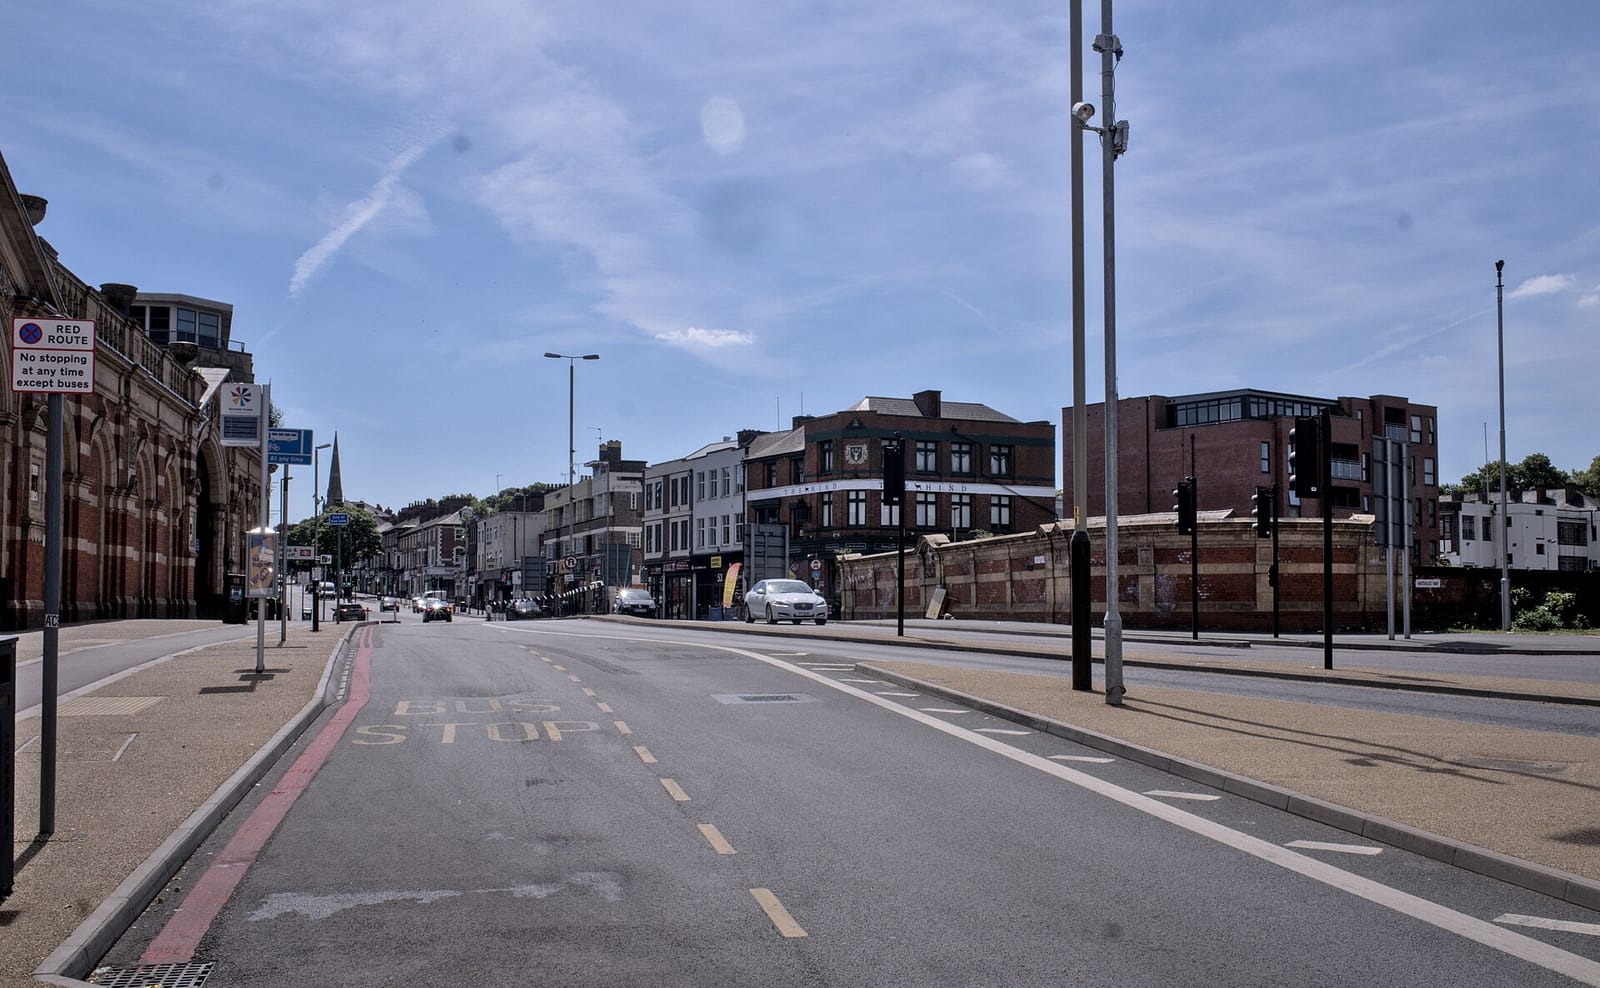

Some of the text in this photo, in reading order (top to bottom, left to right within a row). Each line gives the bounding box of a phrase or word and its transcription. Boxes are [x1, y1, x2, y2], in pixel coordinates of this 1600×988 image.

[56, 325, 81, 334] RED
[48, 335, 88, 345] ROUTE
[20, 353, 87, 365] No stopping
[22, 367, 84, 377] at any time
[16, 379, 89, 389] except buses
[394, 699, 561, 716] BUS
[352, 720, 601, 745] STOP
